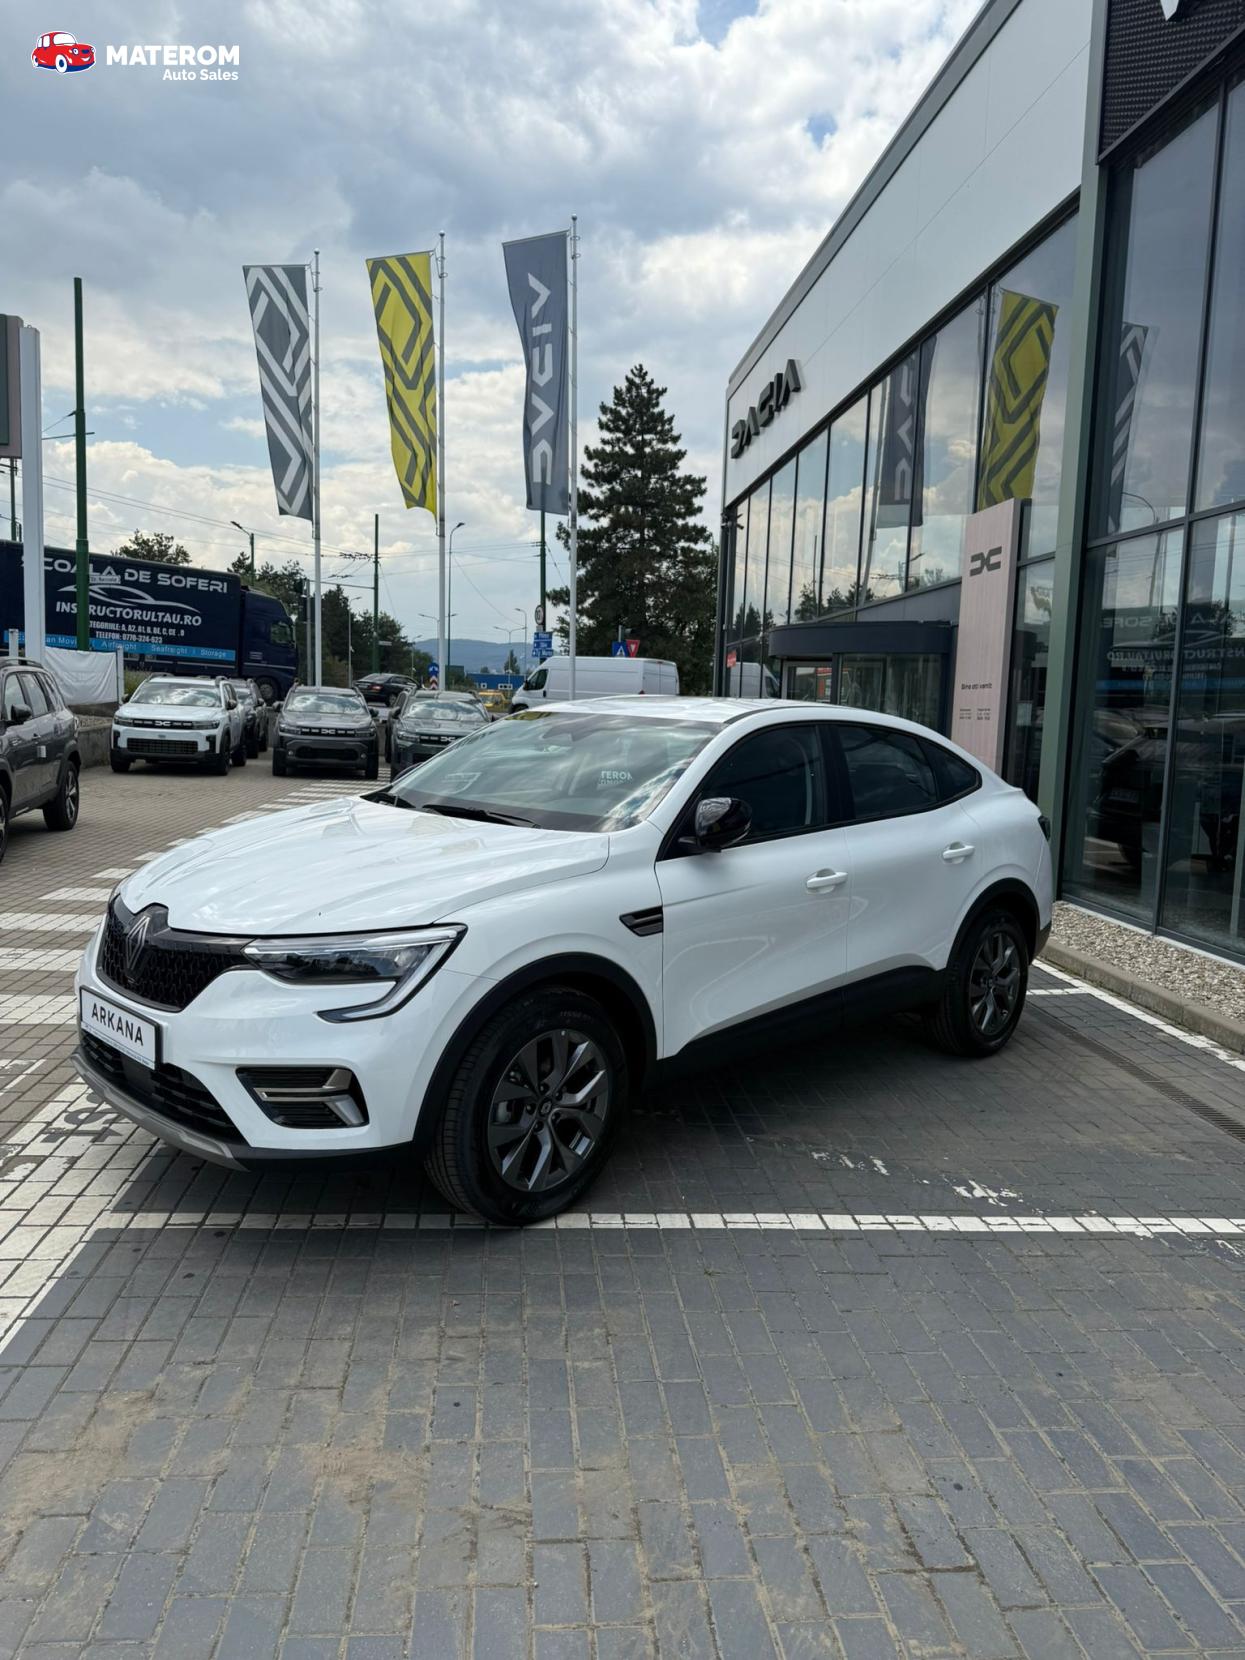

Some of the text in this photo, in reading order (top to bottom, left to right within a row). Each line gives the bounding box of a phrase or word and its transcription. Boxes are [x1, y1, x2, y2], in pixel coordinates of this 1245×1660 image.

[527, 272, 555, 486] DACIA
[731, 359, 801, 460] DACIA
[124, 568, 151, 583] DE
[157, 573, 228, 593] SOFERI
[56, 601, 202, 626] INSRUCTORULTAU.RO
[89, 620, 120, 631] TEGORIILE:
[91, 1002, 143, 1046] ARKANA
